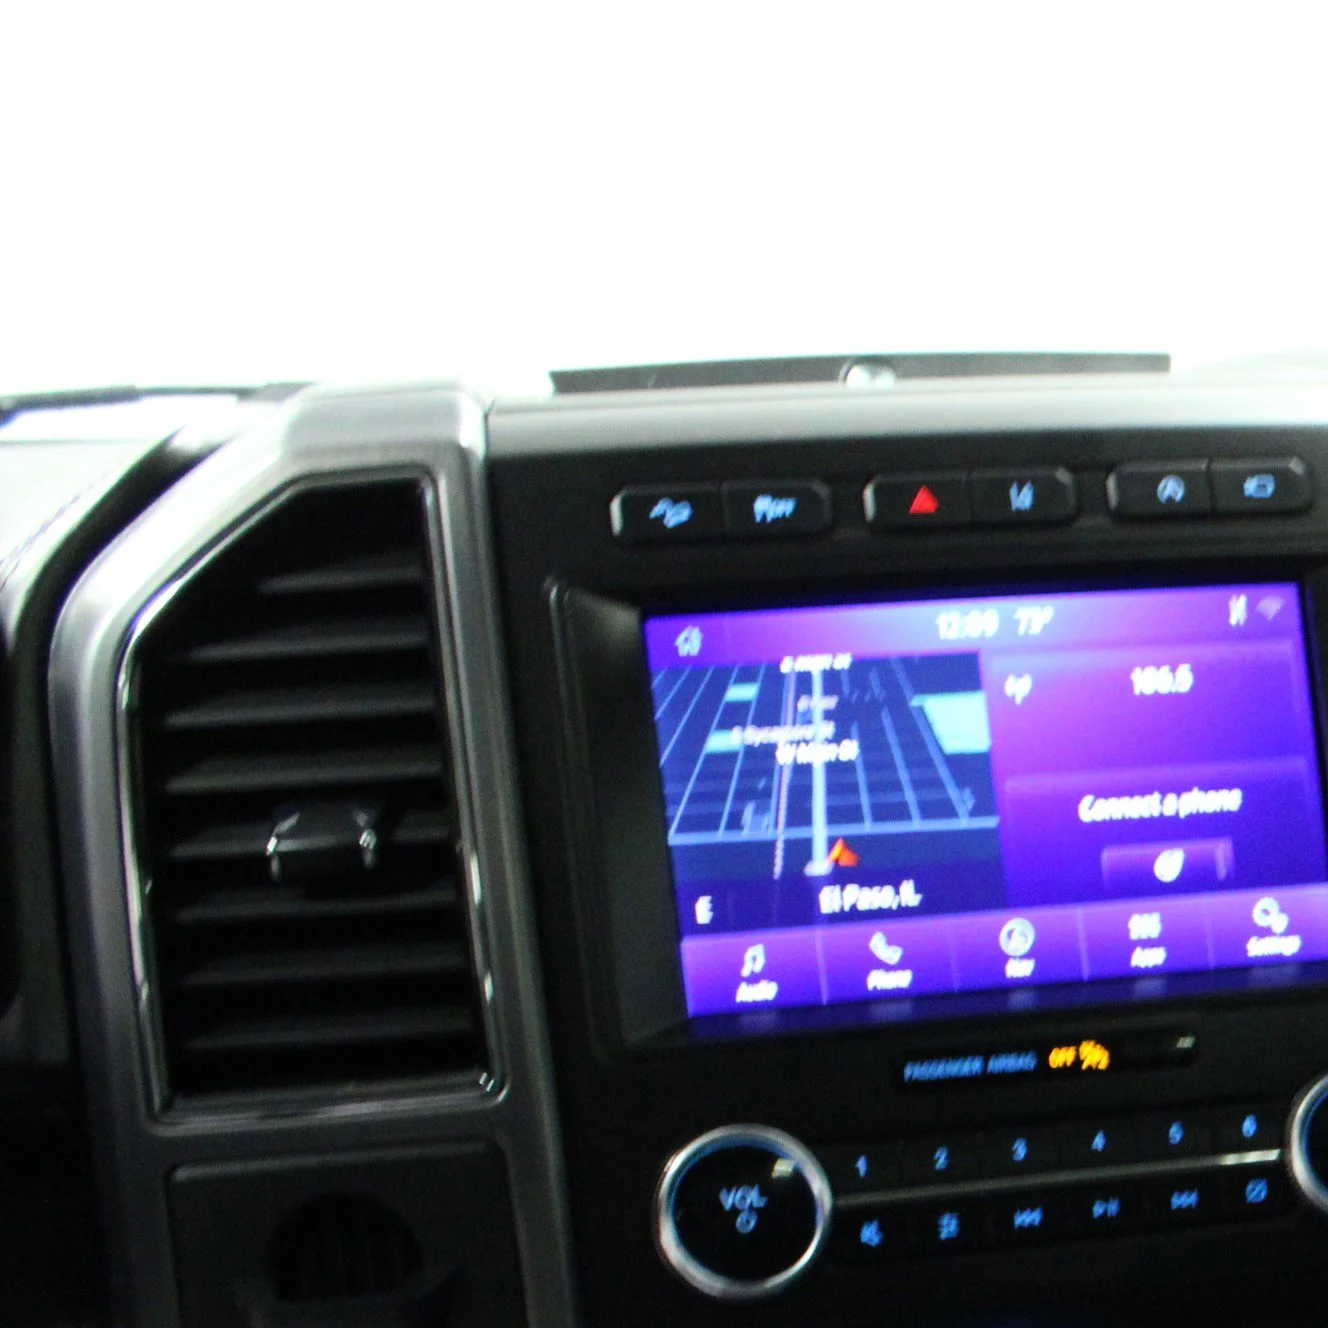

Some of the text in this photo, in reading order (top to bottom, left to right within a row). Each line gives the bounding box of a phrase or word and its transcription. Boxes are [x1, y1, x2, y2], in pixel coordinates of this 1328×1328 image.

[1078, 787, 1243, 823] Connect a phone
[819, 885, 842, 914] El
[867, 969, 912, 990] Phone
[719, 1185, 767, 1212] VOL
